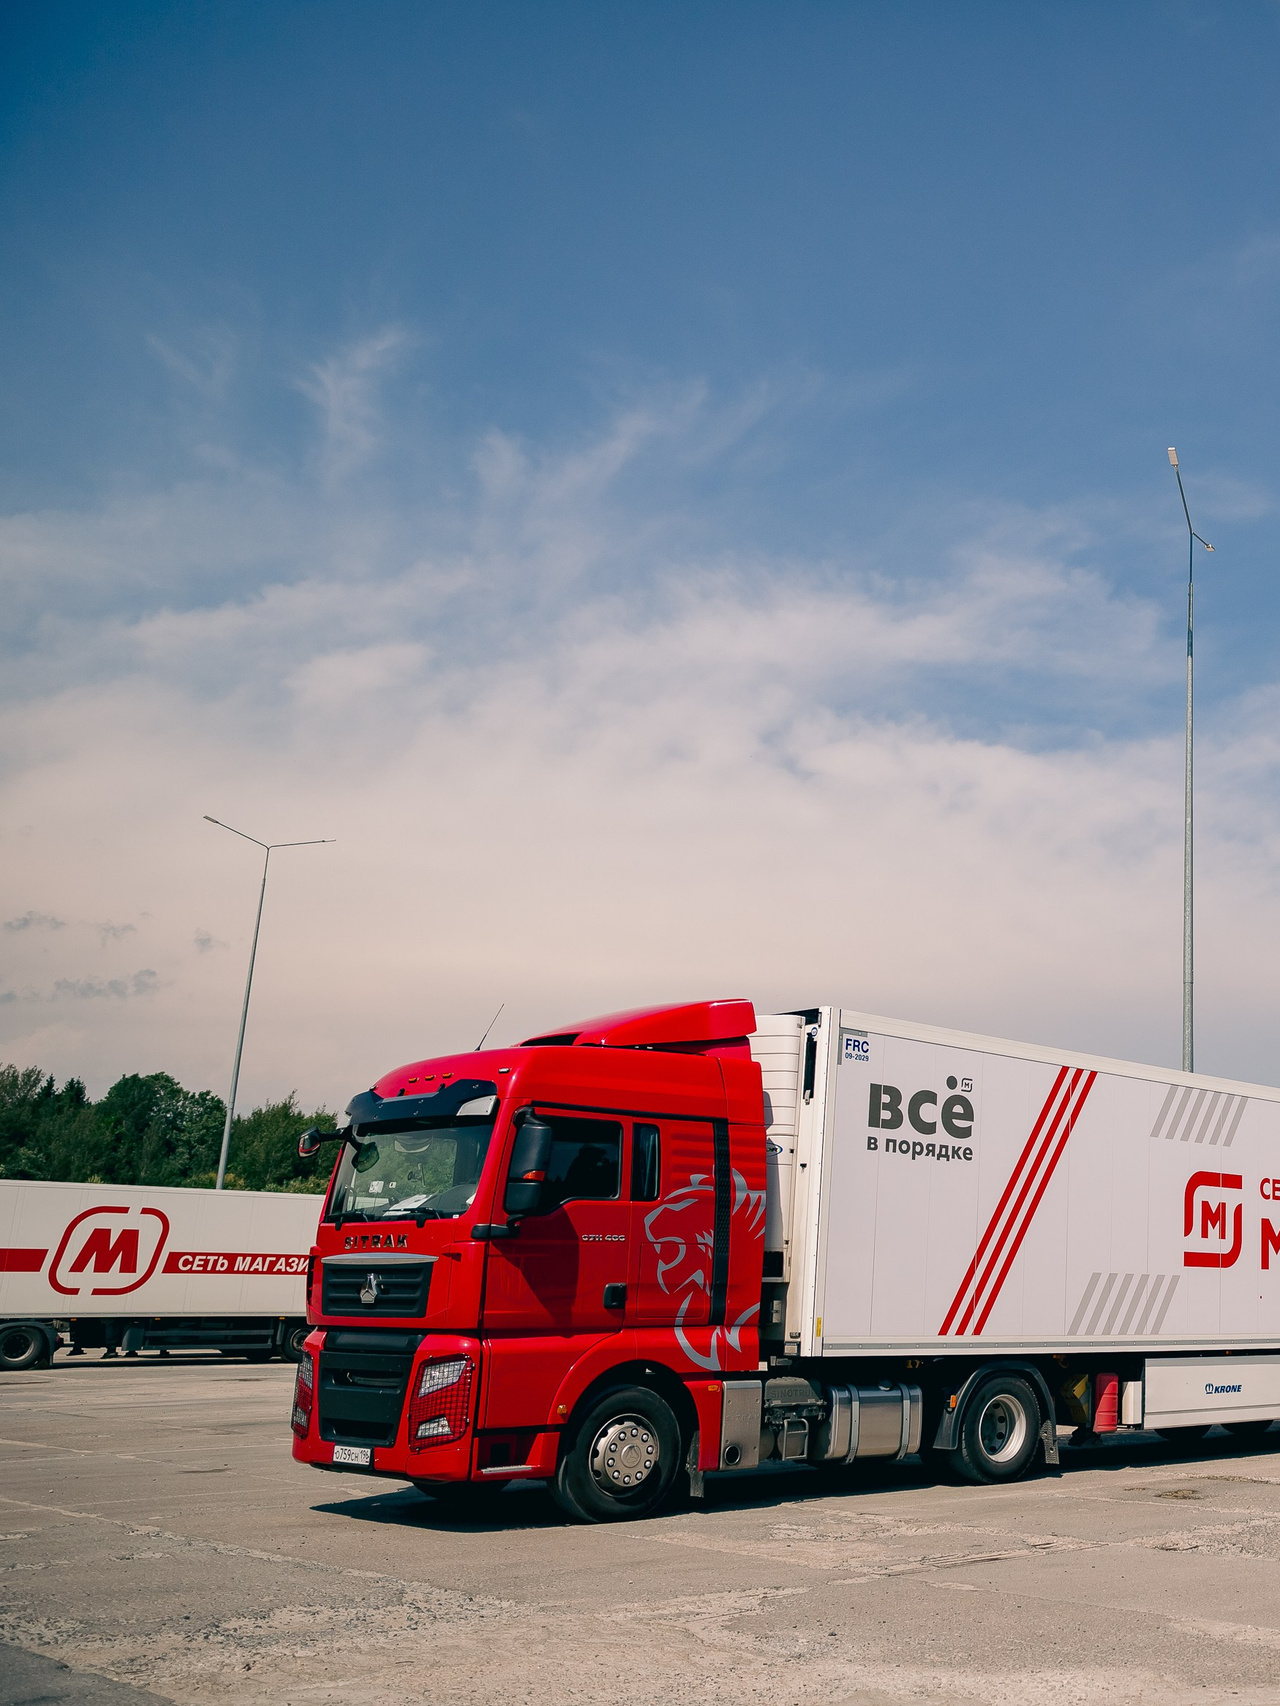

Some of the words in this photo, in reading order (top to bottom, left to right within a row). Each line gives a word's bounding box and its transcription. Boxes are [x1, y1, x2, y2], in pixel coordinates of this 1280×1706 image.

[845, 1038, 870, 1054] FRC
[844, 1052, 870, 1062] 09-2029
[885, 1138, 973, 1162] порядке
[344, 1233, 408, 1250] SITRAK
[1214, 1384, 1242, 1394] KRONE
